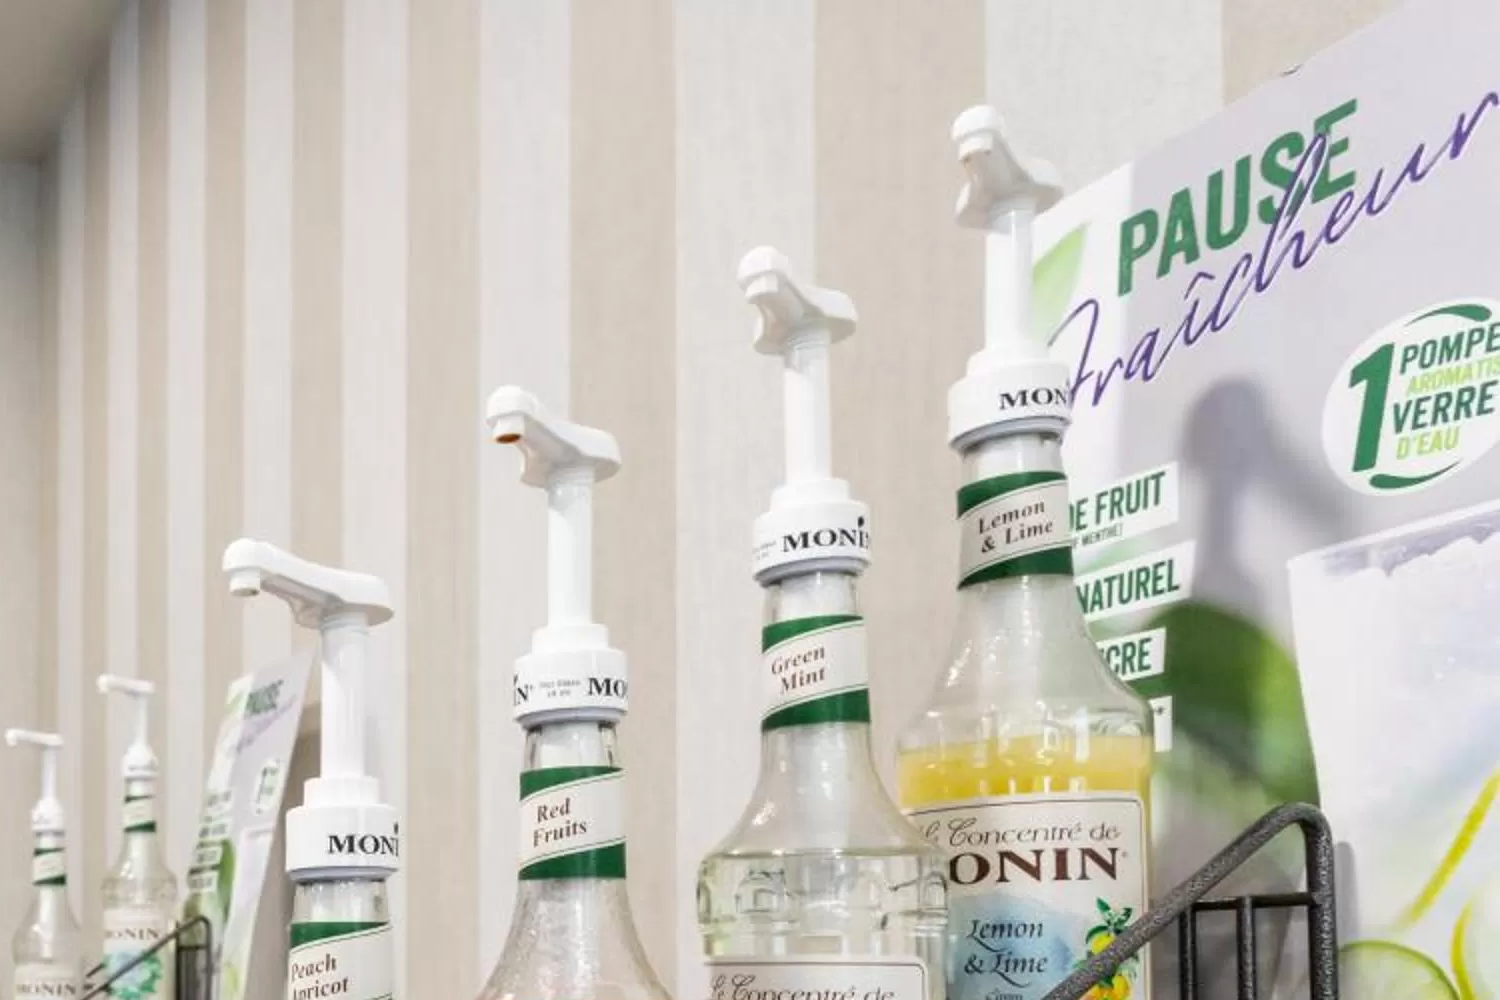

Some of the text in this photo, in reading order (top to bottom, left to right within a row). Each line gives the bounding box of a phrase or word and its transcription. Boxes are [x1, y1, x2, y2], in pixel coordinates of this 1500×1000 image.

[1118, 98, 1358, 297] PAUSE
[1400, 321, 1500, 376] POMPE
[1348, 342, 1395, 472] 1
[1393, 380, 1500, 434] VERRE
[1396, 425, 1461, 460] D'EAU
[1095, 471, 1166, 526] FRUIT
[978, 501, 1045, 534] Lemon
[783, 527, 869, 553] MONI
[981, 536, 997, 554] &
[1005, 521, 1053, 545] Lime
[1076, 558, 1181, 614] NATUREL
[771, 646, 826, 677] Green
[1100, 636, 1153, 676] CRE
[780, 666, 826, 695] Mint
[536, 797, 572, 824] Red
[532, 818, 588, 849] Fruits
[948, 817, 1082, 847] Concentré
[1089, 821, 1121, 842] de
[949, 847, 1119, 885] ONIN
[966, 919, 1045, 953] Lemon
[291, 953, 337, 983] Peach
[964, 952, 1048, 988] & Lime
